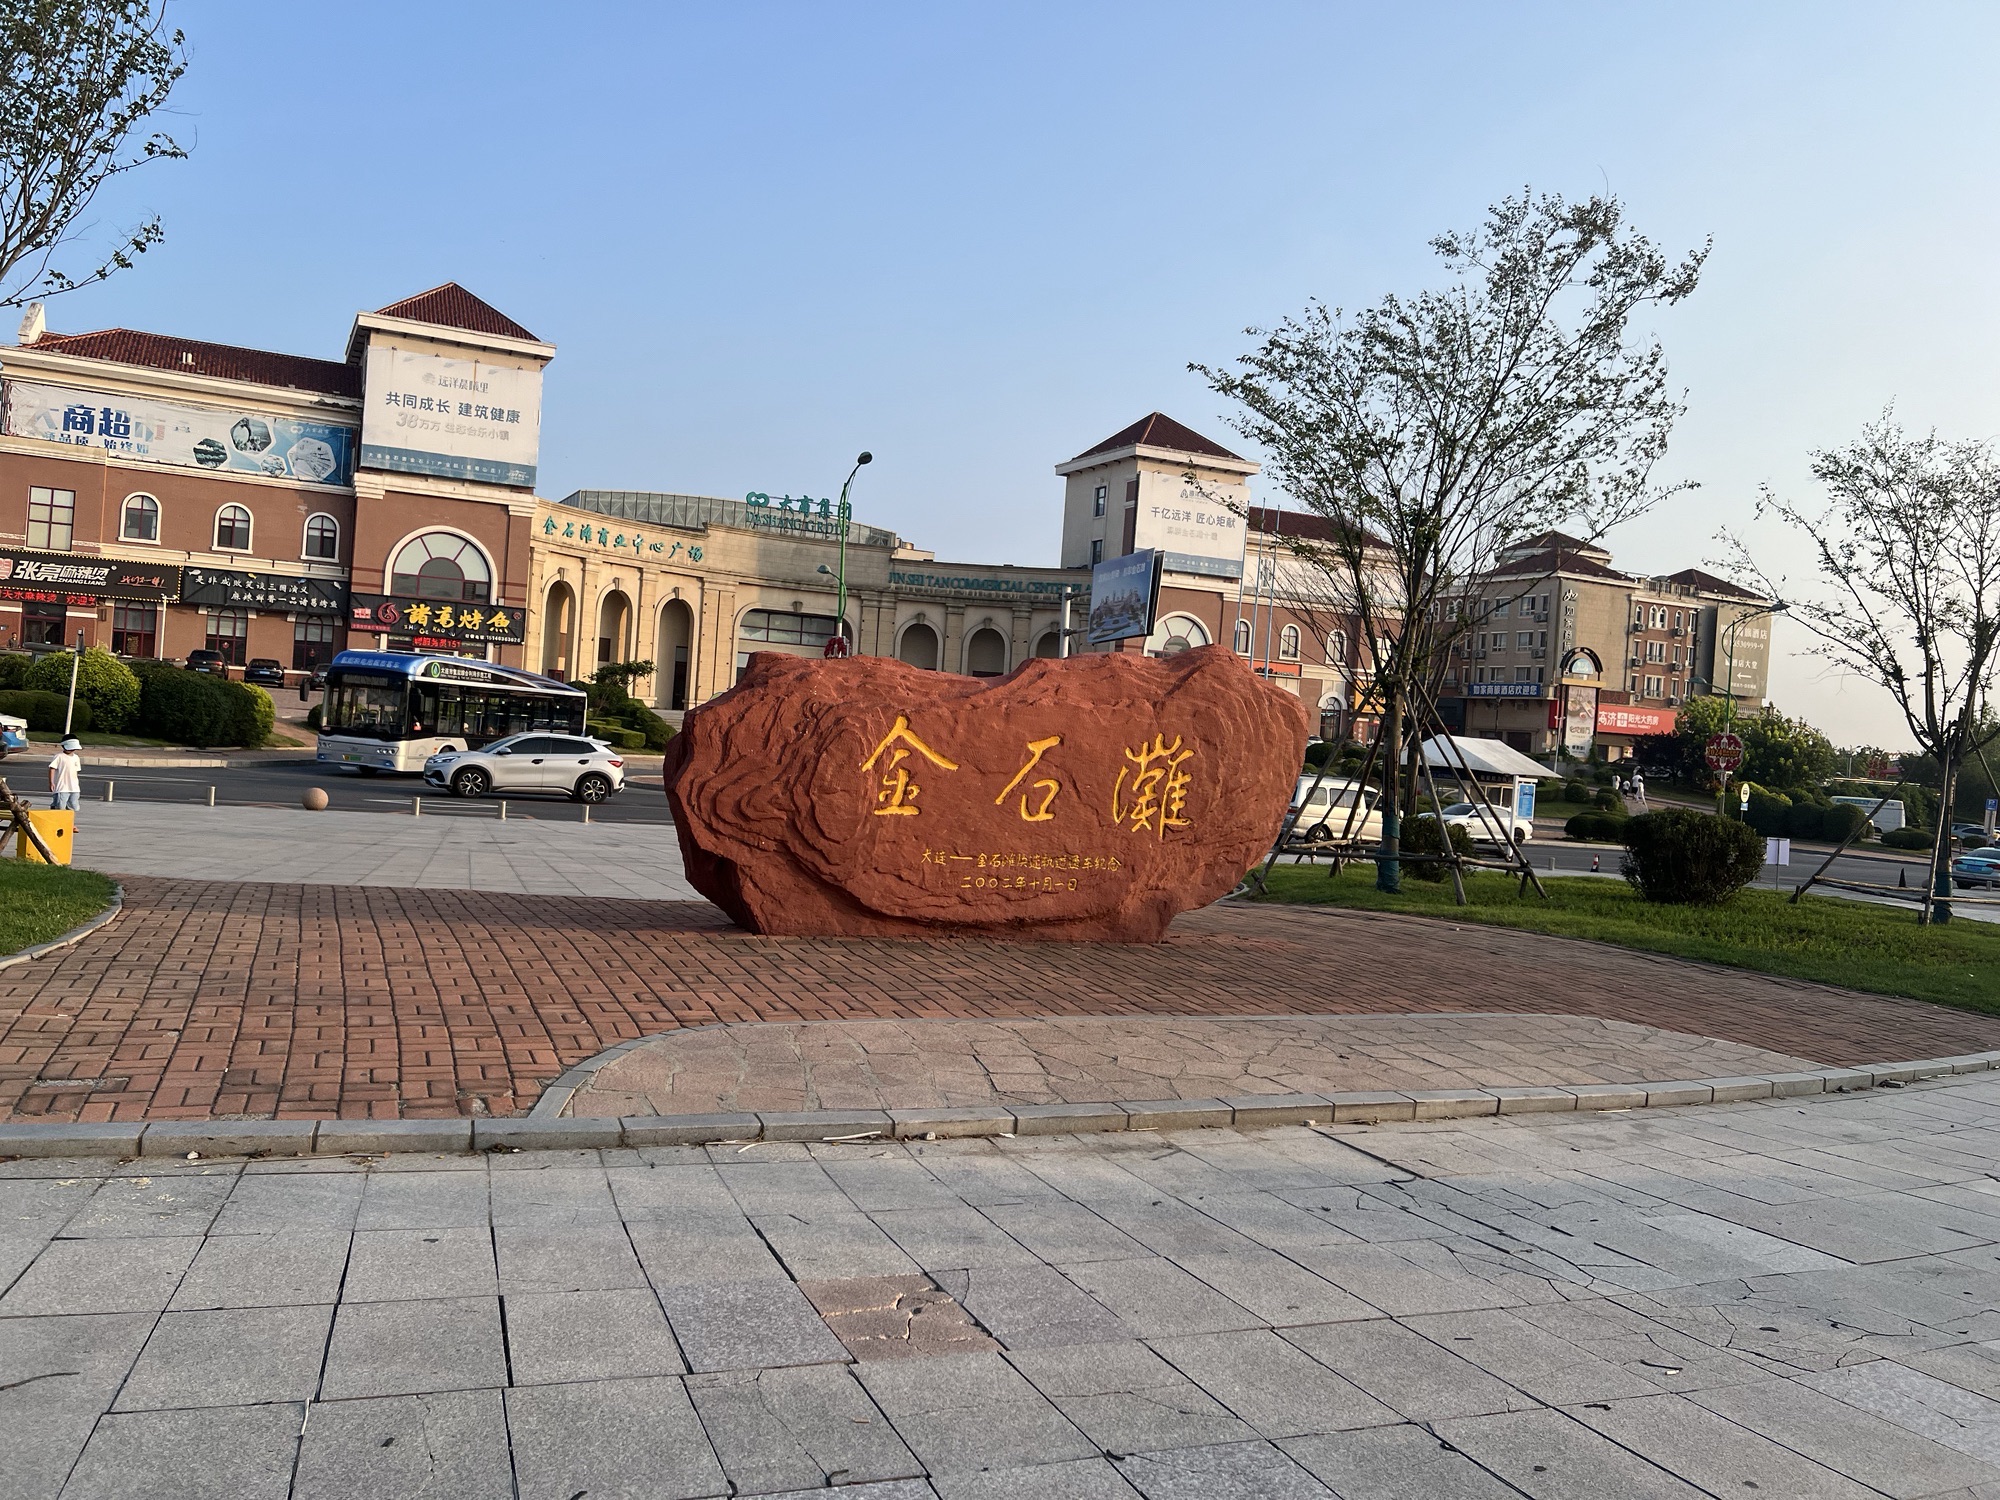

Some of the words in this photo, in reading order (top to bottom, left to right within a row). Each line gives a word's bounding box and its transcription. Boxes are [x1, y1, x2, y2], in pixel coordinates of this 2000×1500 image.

[385, 391, 450, 414] 共同成长
[458, 402, 521, 424] 建筑健康
[777, 494, 852, 521] 大商集团
[1151, 506, 1191, 522] 千亿远洋
[746, 511, 801, 531] DASHANG
[543, 515, 704, 562] 金石滩商业中心广场
[13, 560, 110, 582] 张亮麻辣烫
[951, 577, 1025, 592] COMMERCIAL
[1473, 685, 1538, 696] 如家商旅酒店欢迎您
[1628, 713, 1660, 726] 阳光大药房
